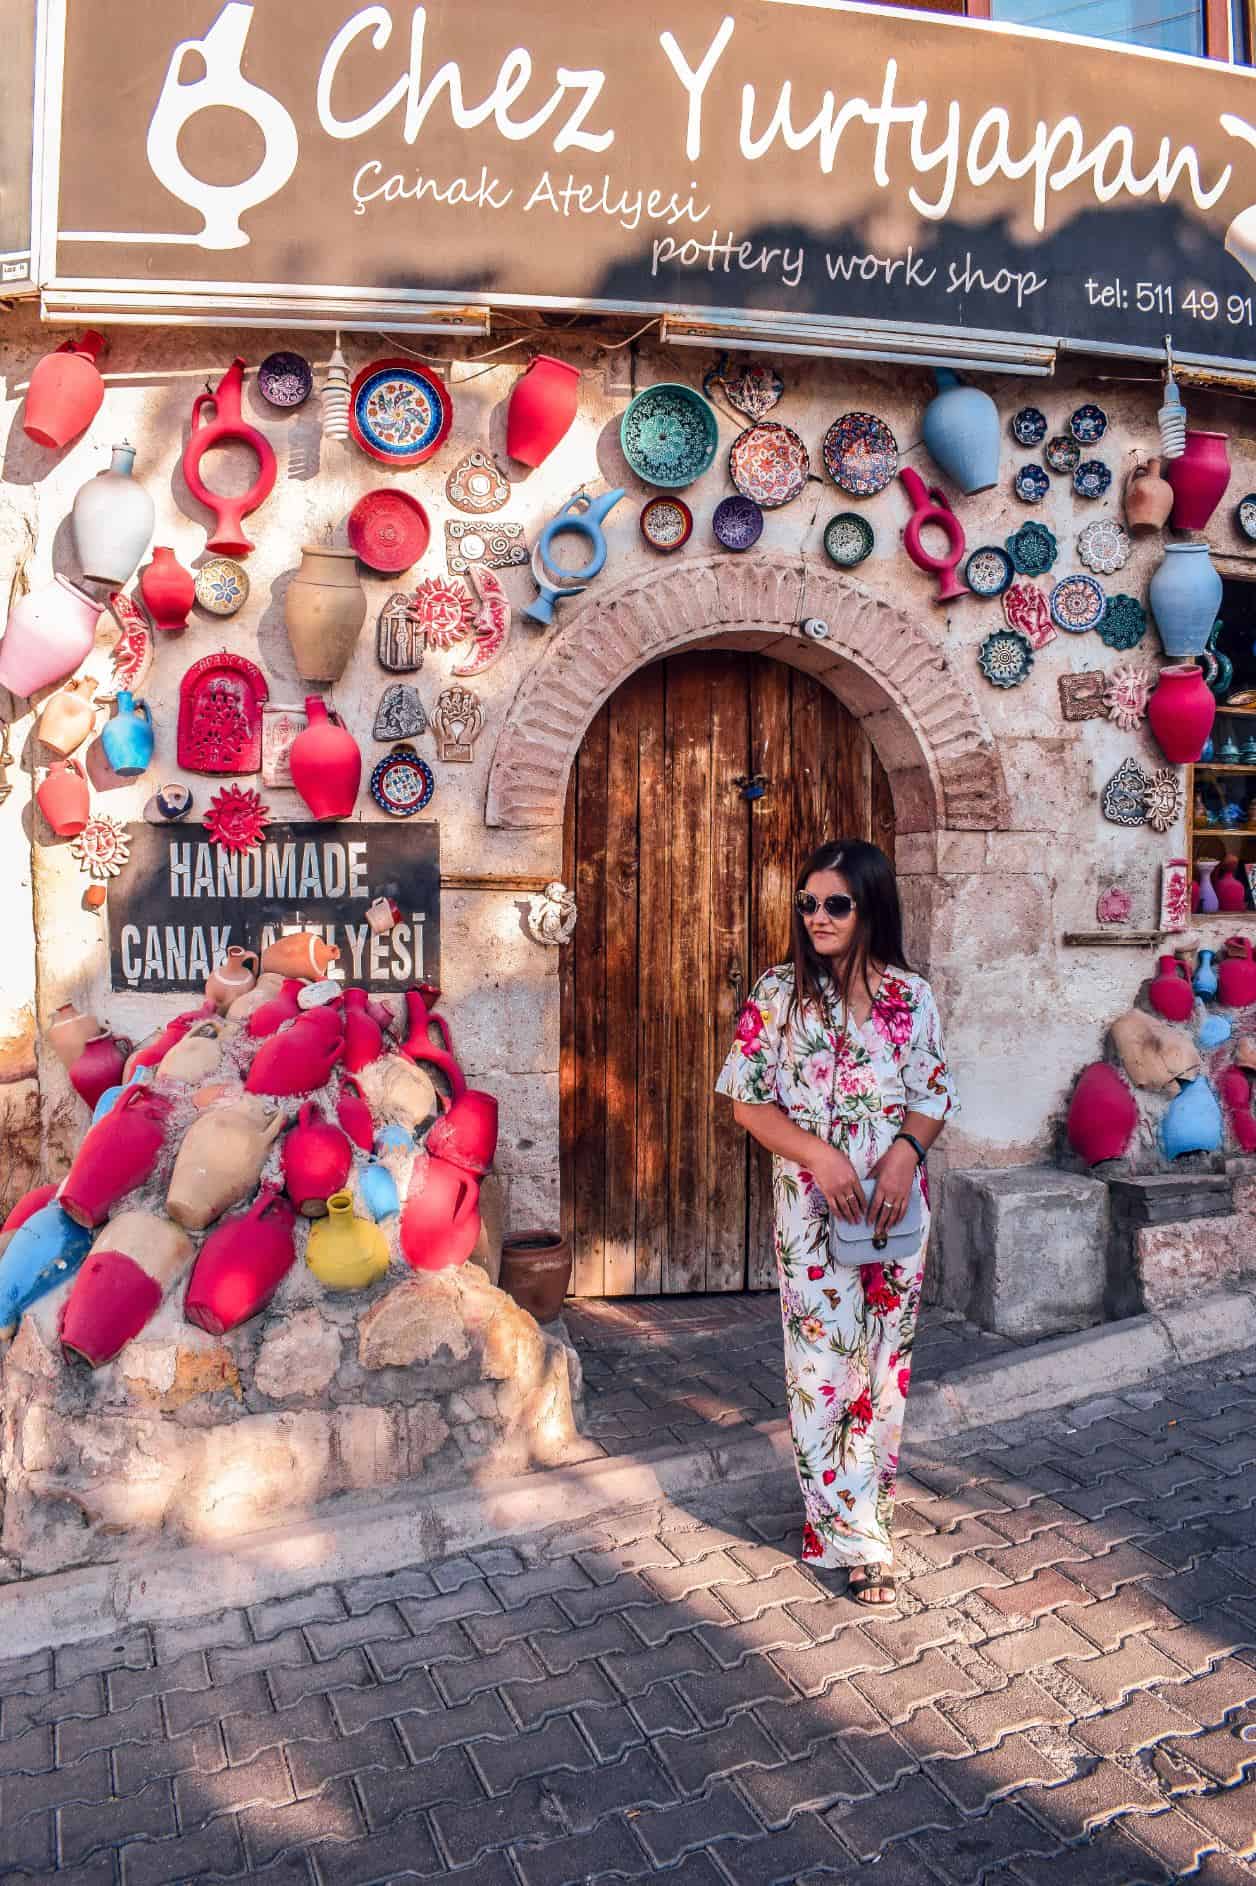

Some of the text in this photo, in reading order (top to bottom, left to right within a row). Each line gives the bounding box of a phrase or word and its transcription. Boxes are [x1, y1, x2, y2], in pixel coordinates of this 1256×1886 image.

[316, 5, 1232, 232] Chez Yurtyapan
[352, 160, 711, 229] Çanak Atelyesi
[651, 230, 1048, 307] pottery work shop
[1084, 278, 1253, 326] tel: 511 49 91
[169, 842, 369, 899] HANDMADE
[120, 912, 426, 986] ÇANAK ALYESİ
